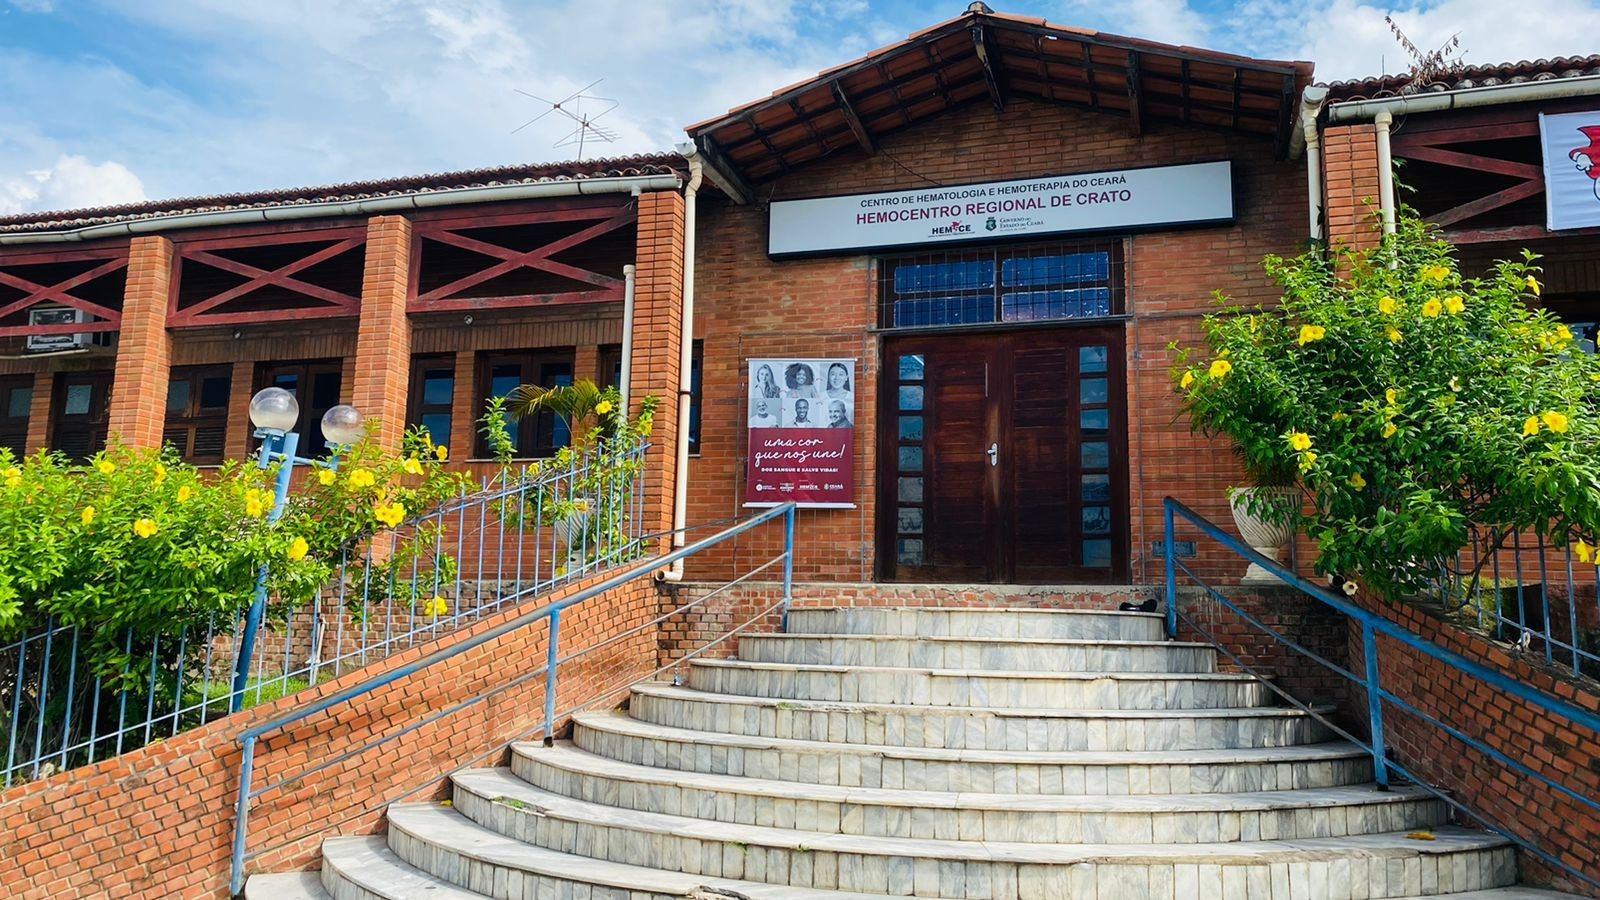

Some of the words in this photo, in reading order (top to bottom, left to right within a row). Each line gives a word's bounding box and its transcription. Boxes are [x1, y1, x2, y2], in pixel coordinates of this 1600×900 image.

[861, 197, 899, 207] CENTRO
[902, 196, 914, 204] DE
[917, 189, 986, 203] HEMATOLOGIA
[989, 188, 995, 196] E
[997, 181, 1070, 195] HEMOTERAPIA
[1072, 179, 1088, 188] DO
[1090, 174, 1127, 186] CEARÁ
[856, 205, 961, 225] HEMOCENTRO
[966, 197, 1046, 216] REGIONAL
[1051, 194, 1072, 207] DE
[1076, 189, 1131, 205] CRATO
[932, 223, 971, 235] HEMCE
[764, 438, 797, 447] uma
[798, 439, 823, 447] cor
[755, 451, 783, 468] que
[784, 450, 811, 463] nos
[812, 444, 846, 458] une!
